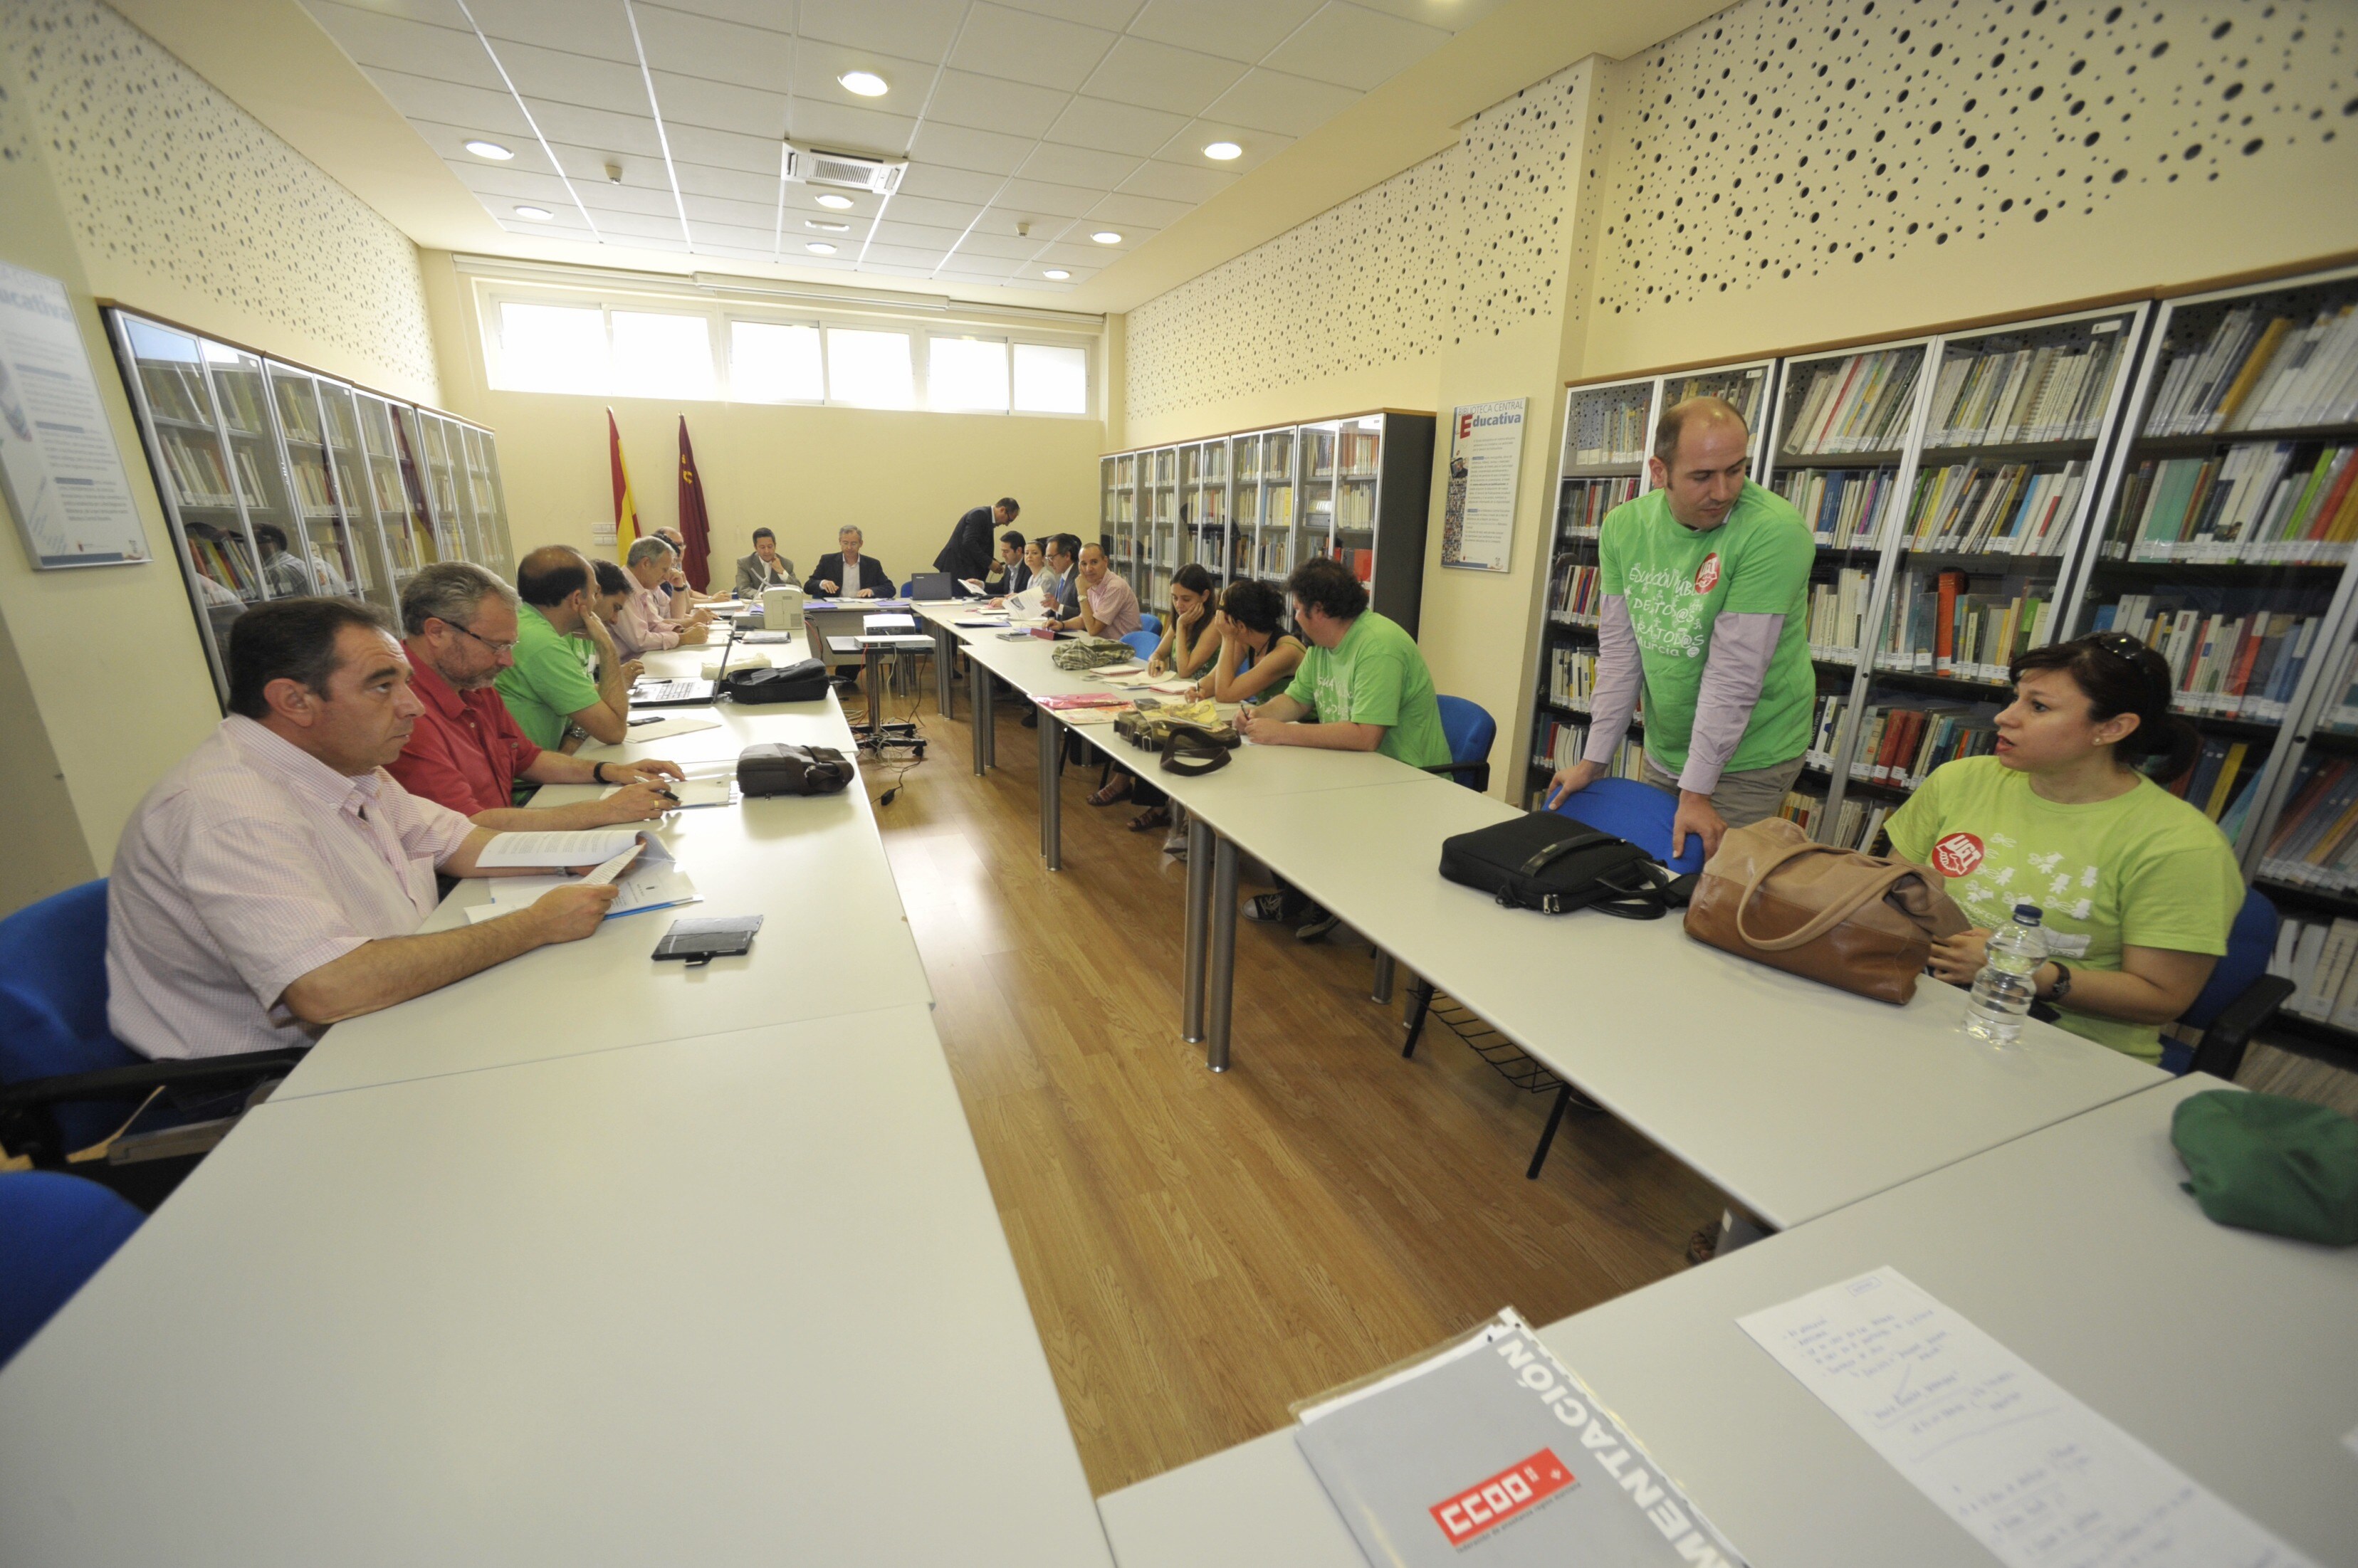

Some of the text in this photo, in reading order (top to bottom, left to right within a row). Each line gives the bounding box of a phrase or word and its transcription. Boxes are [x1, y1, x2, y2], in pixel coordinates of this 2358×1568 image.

[1458, 401, 1523, 416] BIBLIOTECA CENTRAL
[1460, 413, 1521, 439] Educativa
[1633, 598, 1652, 611] DE
[1946, 834, 1983, 865] UGT
[1440, 1473, 1533, 1537] CCOO
